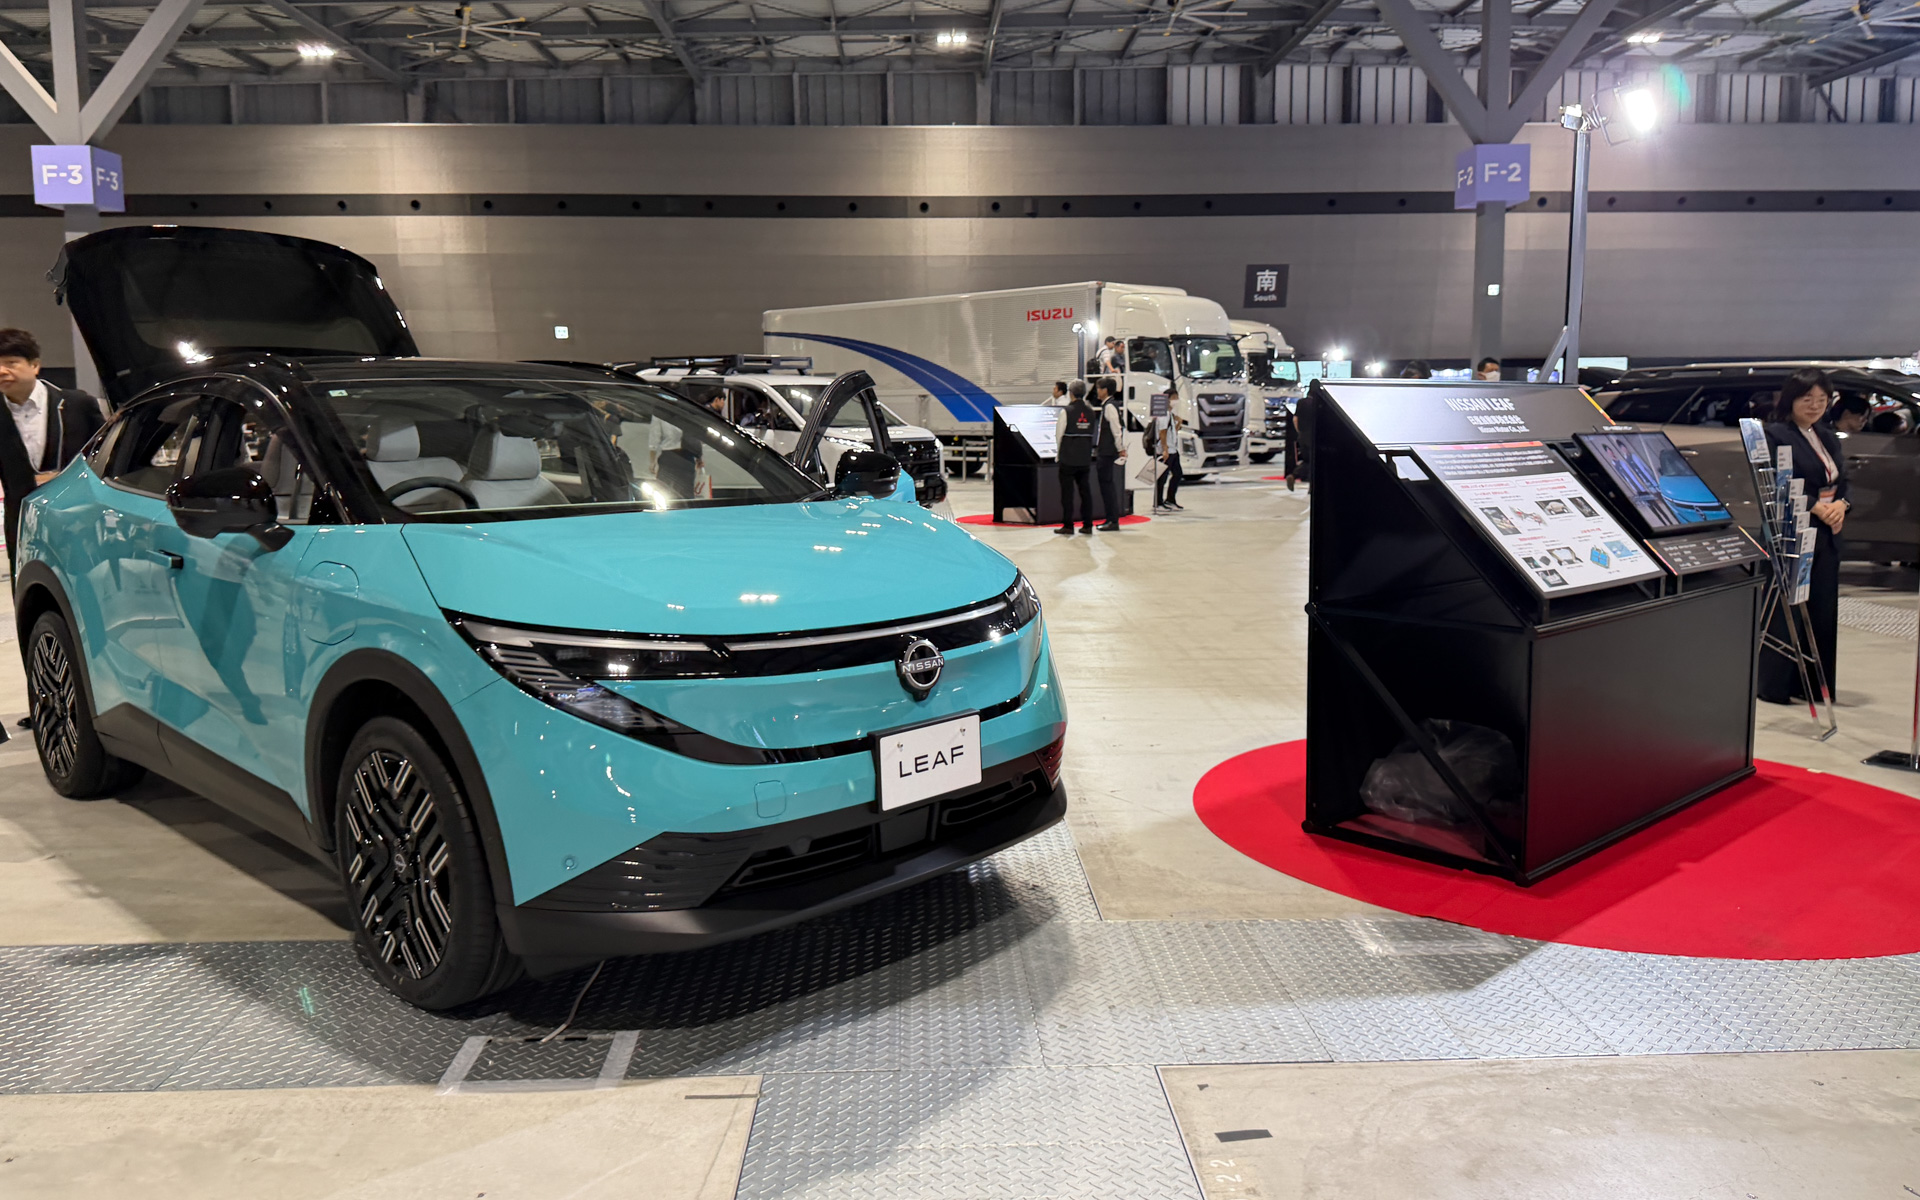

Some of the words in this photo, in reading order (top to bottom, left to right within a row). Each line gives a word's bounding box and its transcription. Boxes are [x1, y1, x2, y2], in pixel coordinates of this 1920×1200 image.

[41, 164, 83, 185] F-3
[95, 166, 119, 191] F-3
[1457, 165, 1474, 189] F-2
[1483, 162, 1522, 183] F-2
[1256, 269, 1278, 292] 南
[1253, 294, 1277, 302] South
[1026, 307, 1073, 322] ISUZU
[1443, 398, 1490, 411] NISSAN
[1485, 398, 1515, 411] LEAF
[902, 658, 944, 673] NISSAN
[899, 745, 964, 778] LEAF
